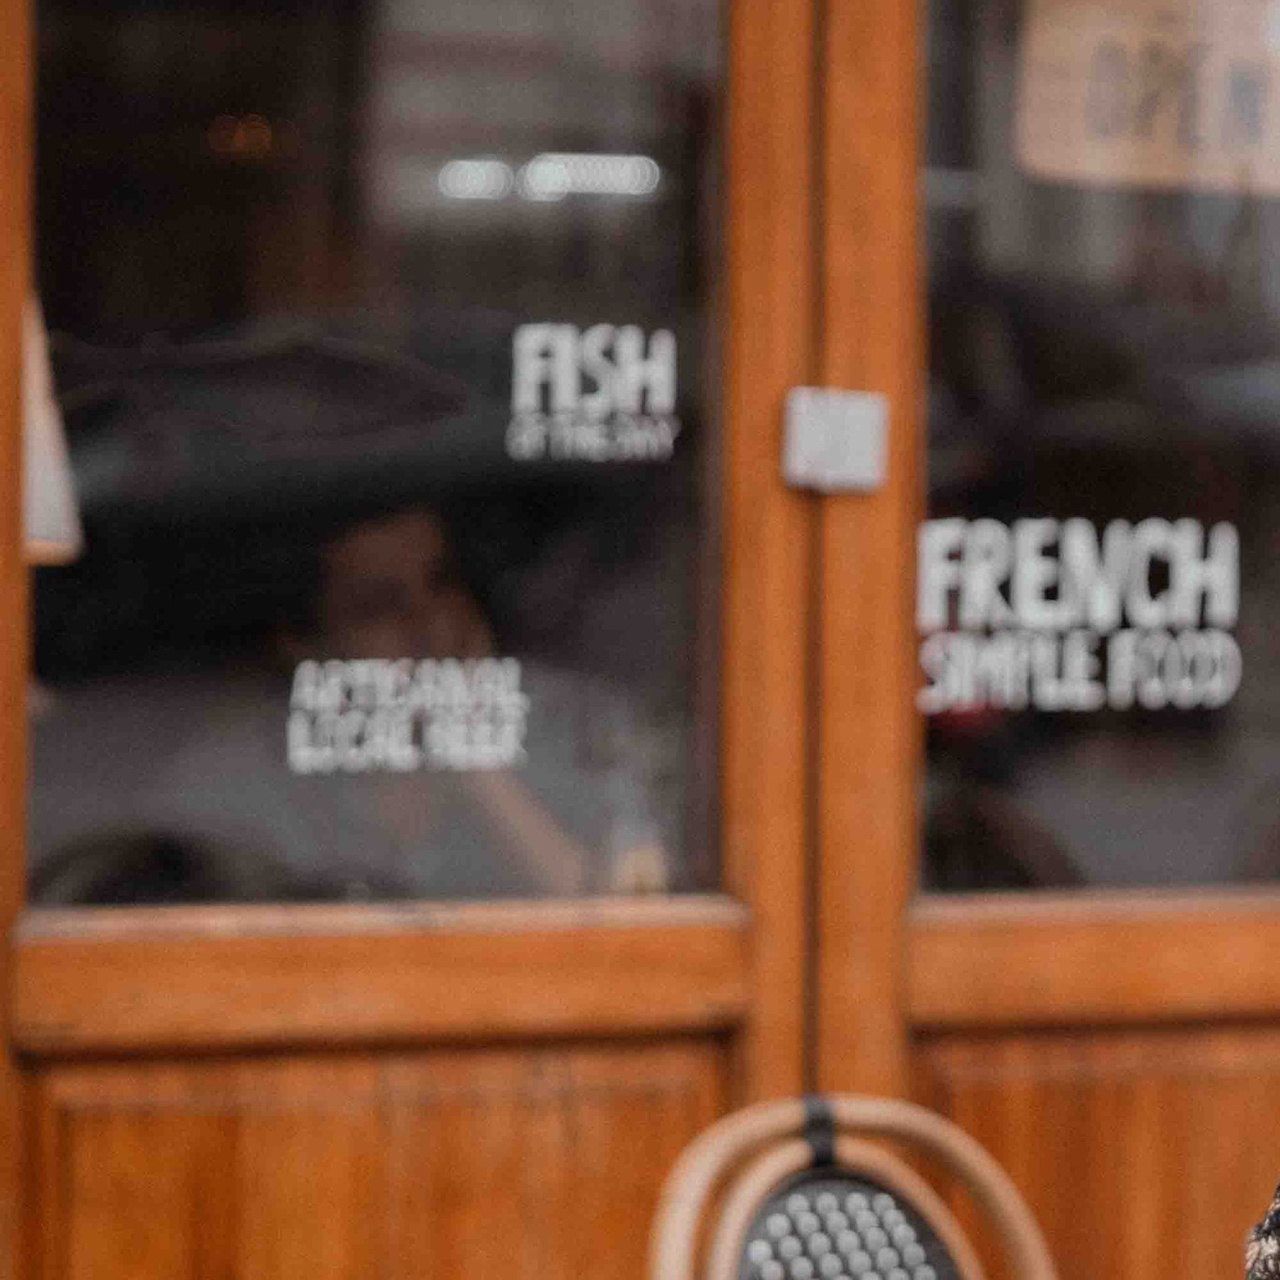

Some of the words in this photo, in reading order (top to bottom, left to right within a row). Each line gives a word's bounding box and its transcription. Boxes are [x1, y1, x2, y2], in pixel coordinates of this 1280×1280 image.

[511, 322, 678, 418] FISH
[917, 517, 1242, 635] FRENCH
[916, 628, 1107, 713] SIMPLE
[1107, 627, 1244, 711] FOOD
